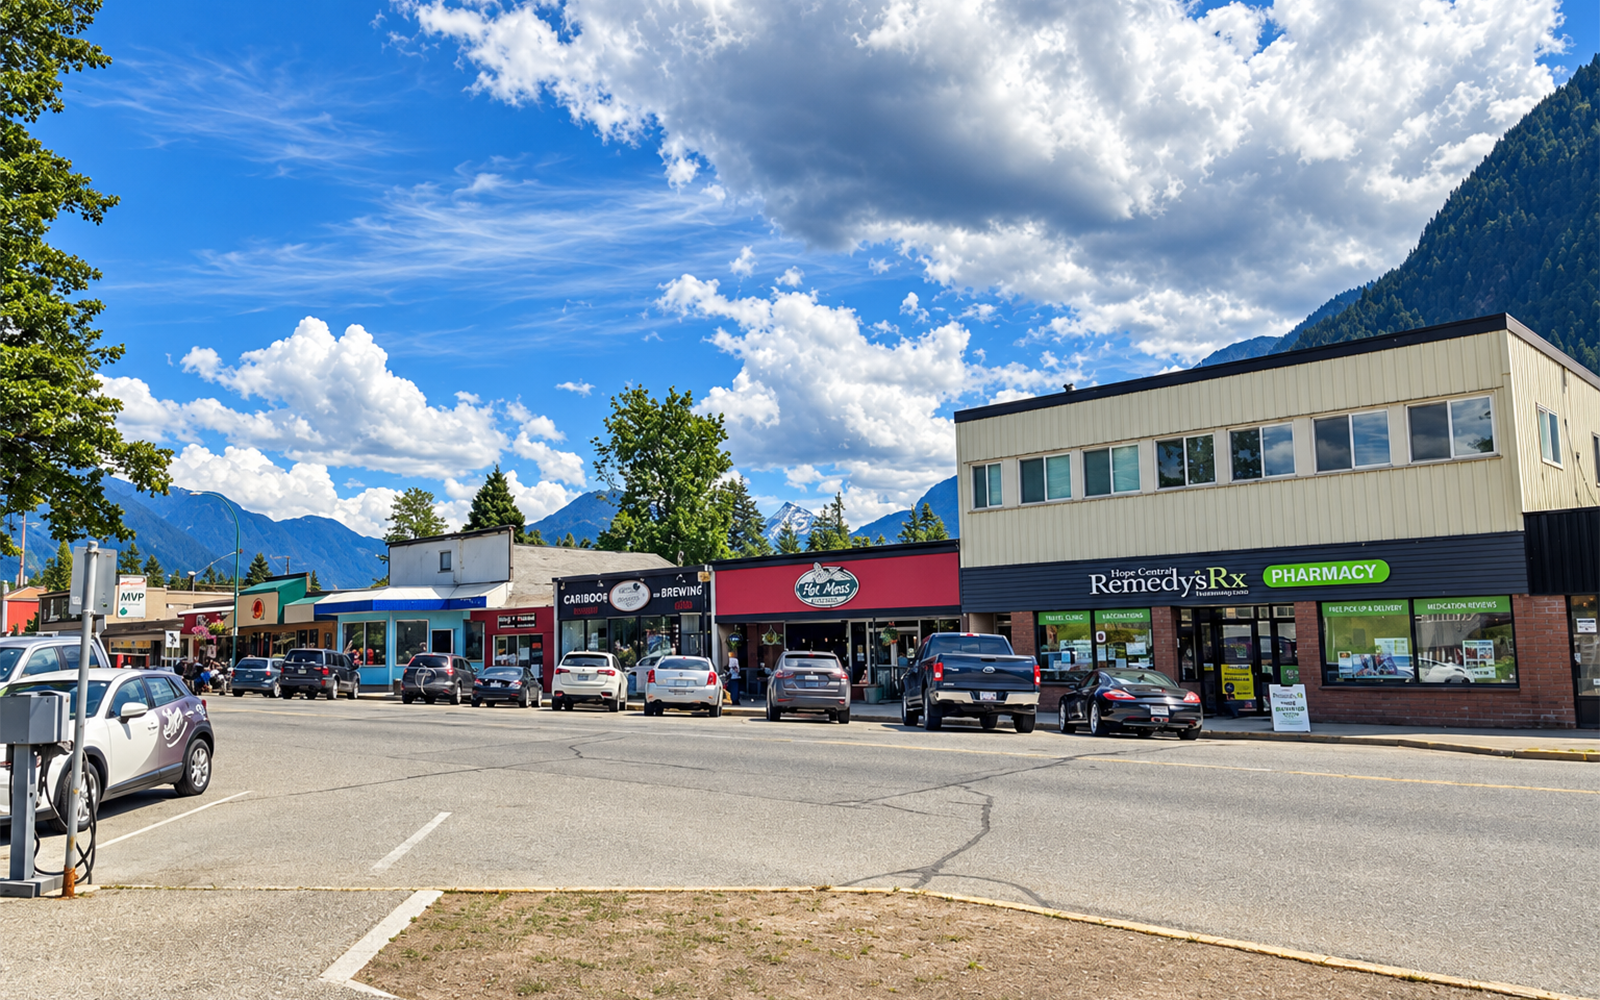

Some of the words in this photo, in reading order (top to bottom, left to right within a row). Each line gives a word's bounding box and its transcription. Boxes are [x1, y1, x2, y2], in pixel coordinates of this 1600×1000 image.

[1111, 569, 1136, 580] Hope
[1138, 567, 1172, 576] Central
[1271, 564, 1377, 583] PHARMACY
[120, 592, 144, 602] MVP
[661, 585, 703, 598] BREWING
